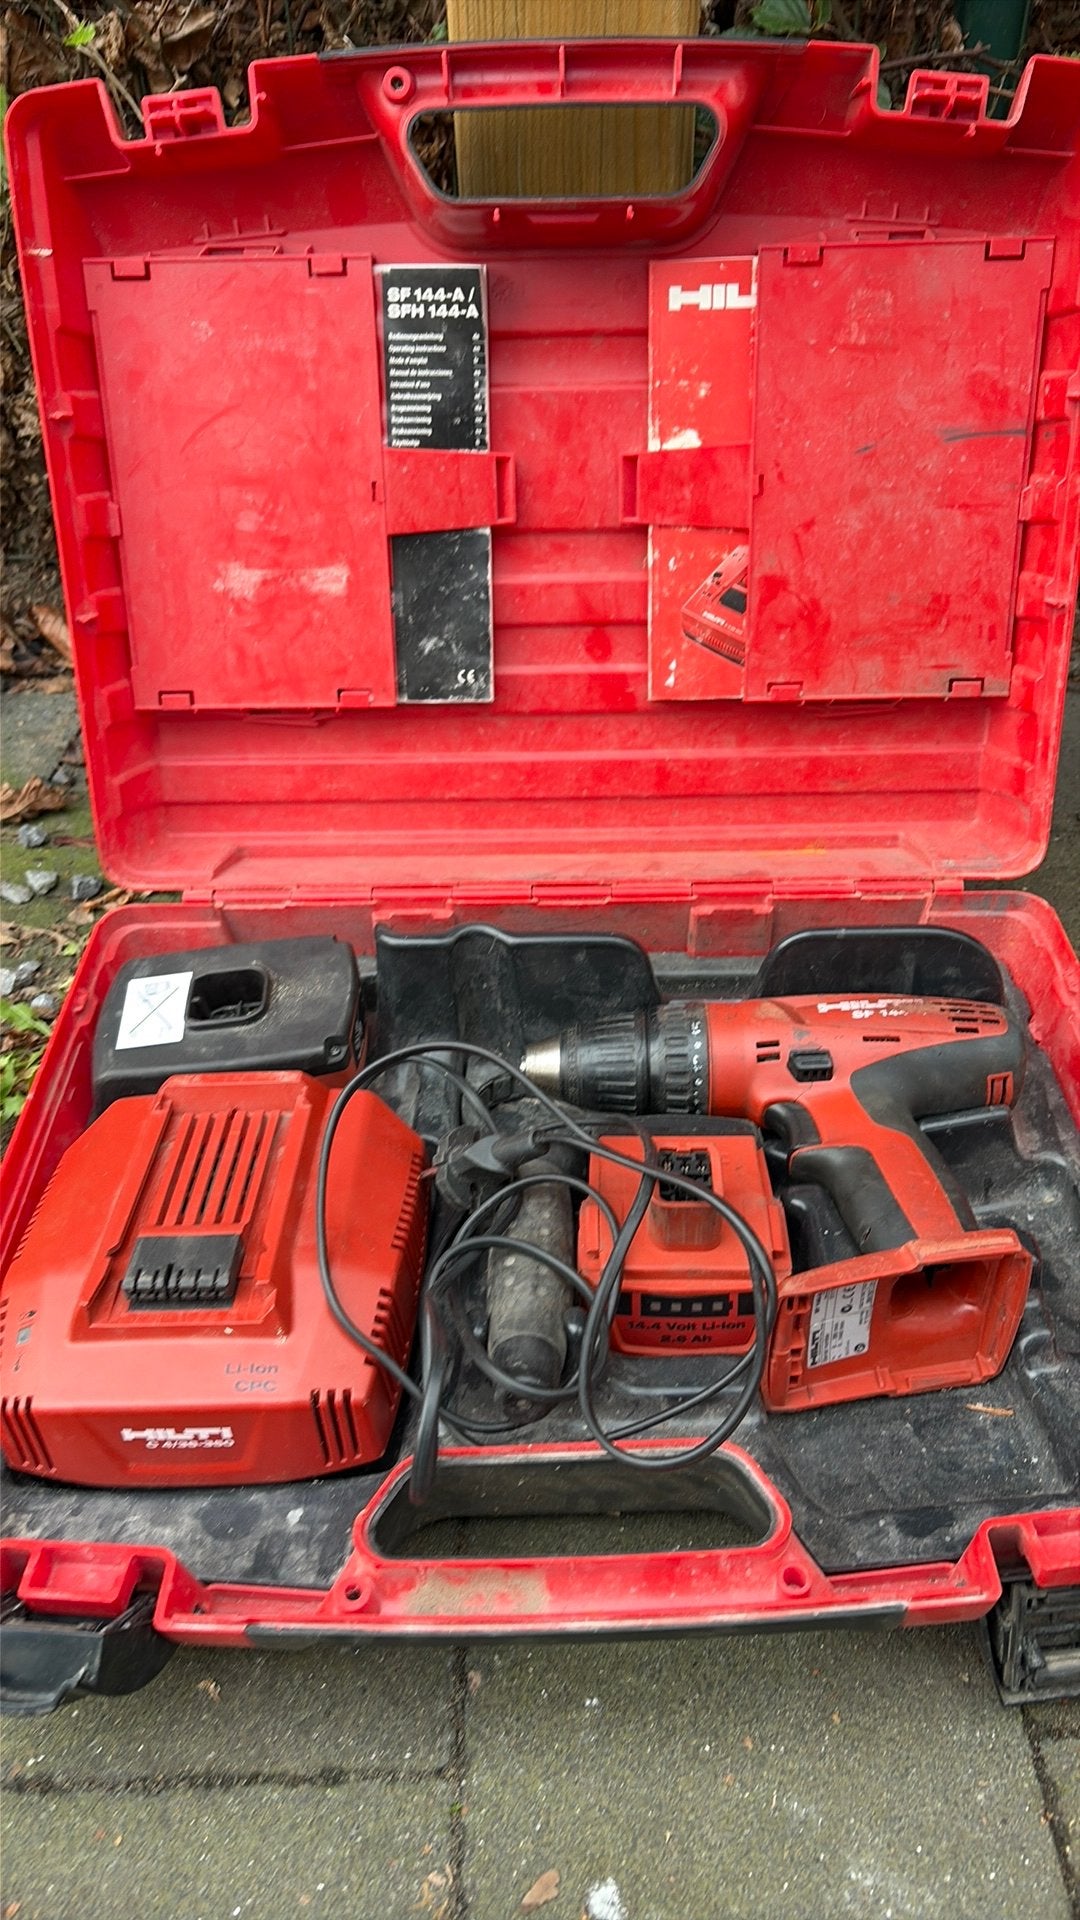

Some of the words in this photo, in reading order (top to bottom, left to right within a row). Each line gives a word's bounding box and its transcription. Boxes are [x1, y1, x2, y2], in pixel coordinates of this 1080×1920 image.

[387, 286, 411, 302] SF
[413, 287, 465, 302] 144-A
[468, 286, 475, 302] /
[387, 303, 425, 319] SFH
[427, 303, 479, 319] 144-A
[388, 344, 415, 354] Operating
[415, 344, 447, 353] instructions
[389, 356, 404, 365] Mode
[389, 368, 410, 377] Manual
[410, 368, 417, 377] de
[417, 368, 453, 377] instrucciones
[457, 669, 475, 684] CE
[627, 1321, 661, 1330] 14.4
[666, 1322, 697, 1331] Volt
[691, 1334, 712, 1343] Ah
[225, 1363, 279, 1375] Li-Ion
[234, 1380, 277, 1392] CPC
[121, 1426, 233, 1441] HILTI
